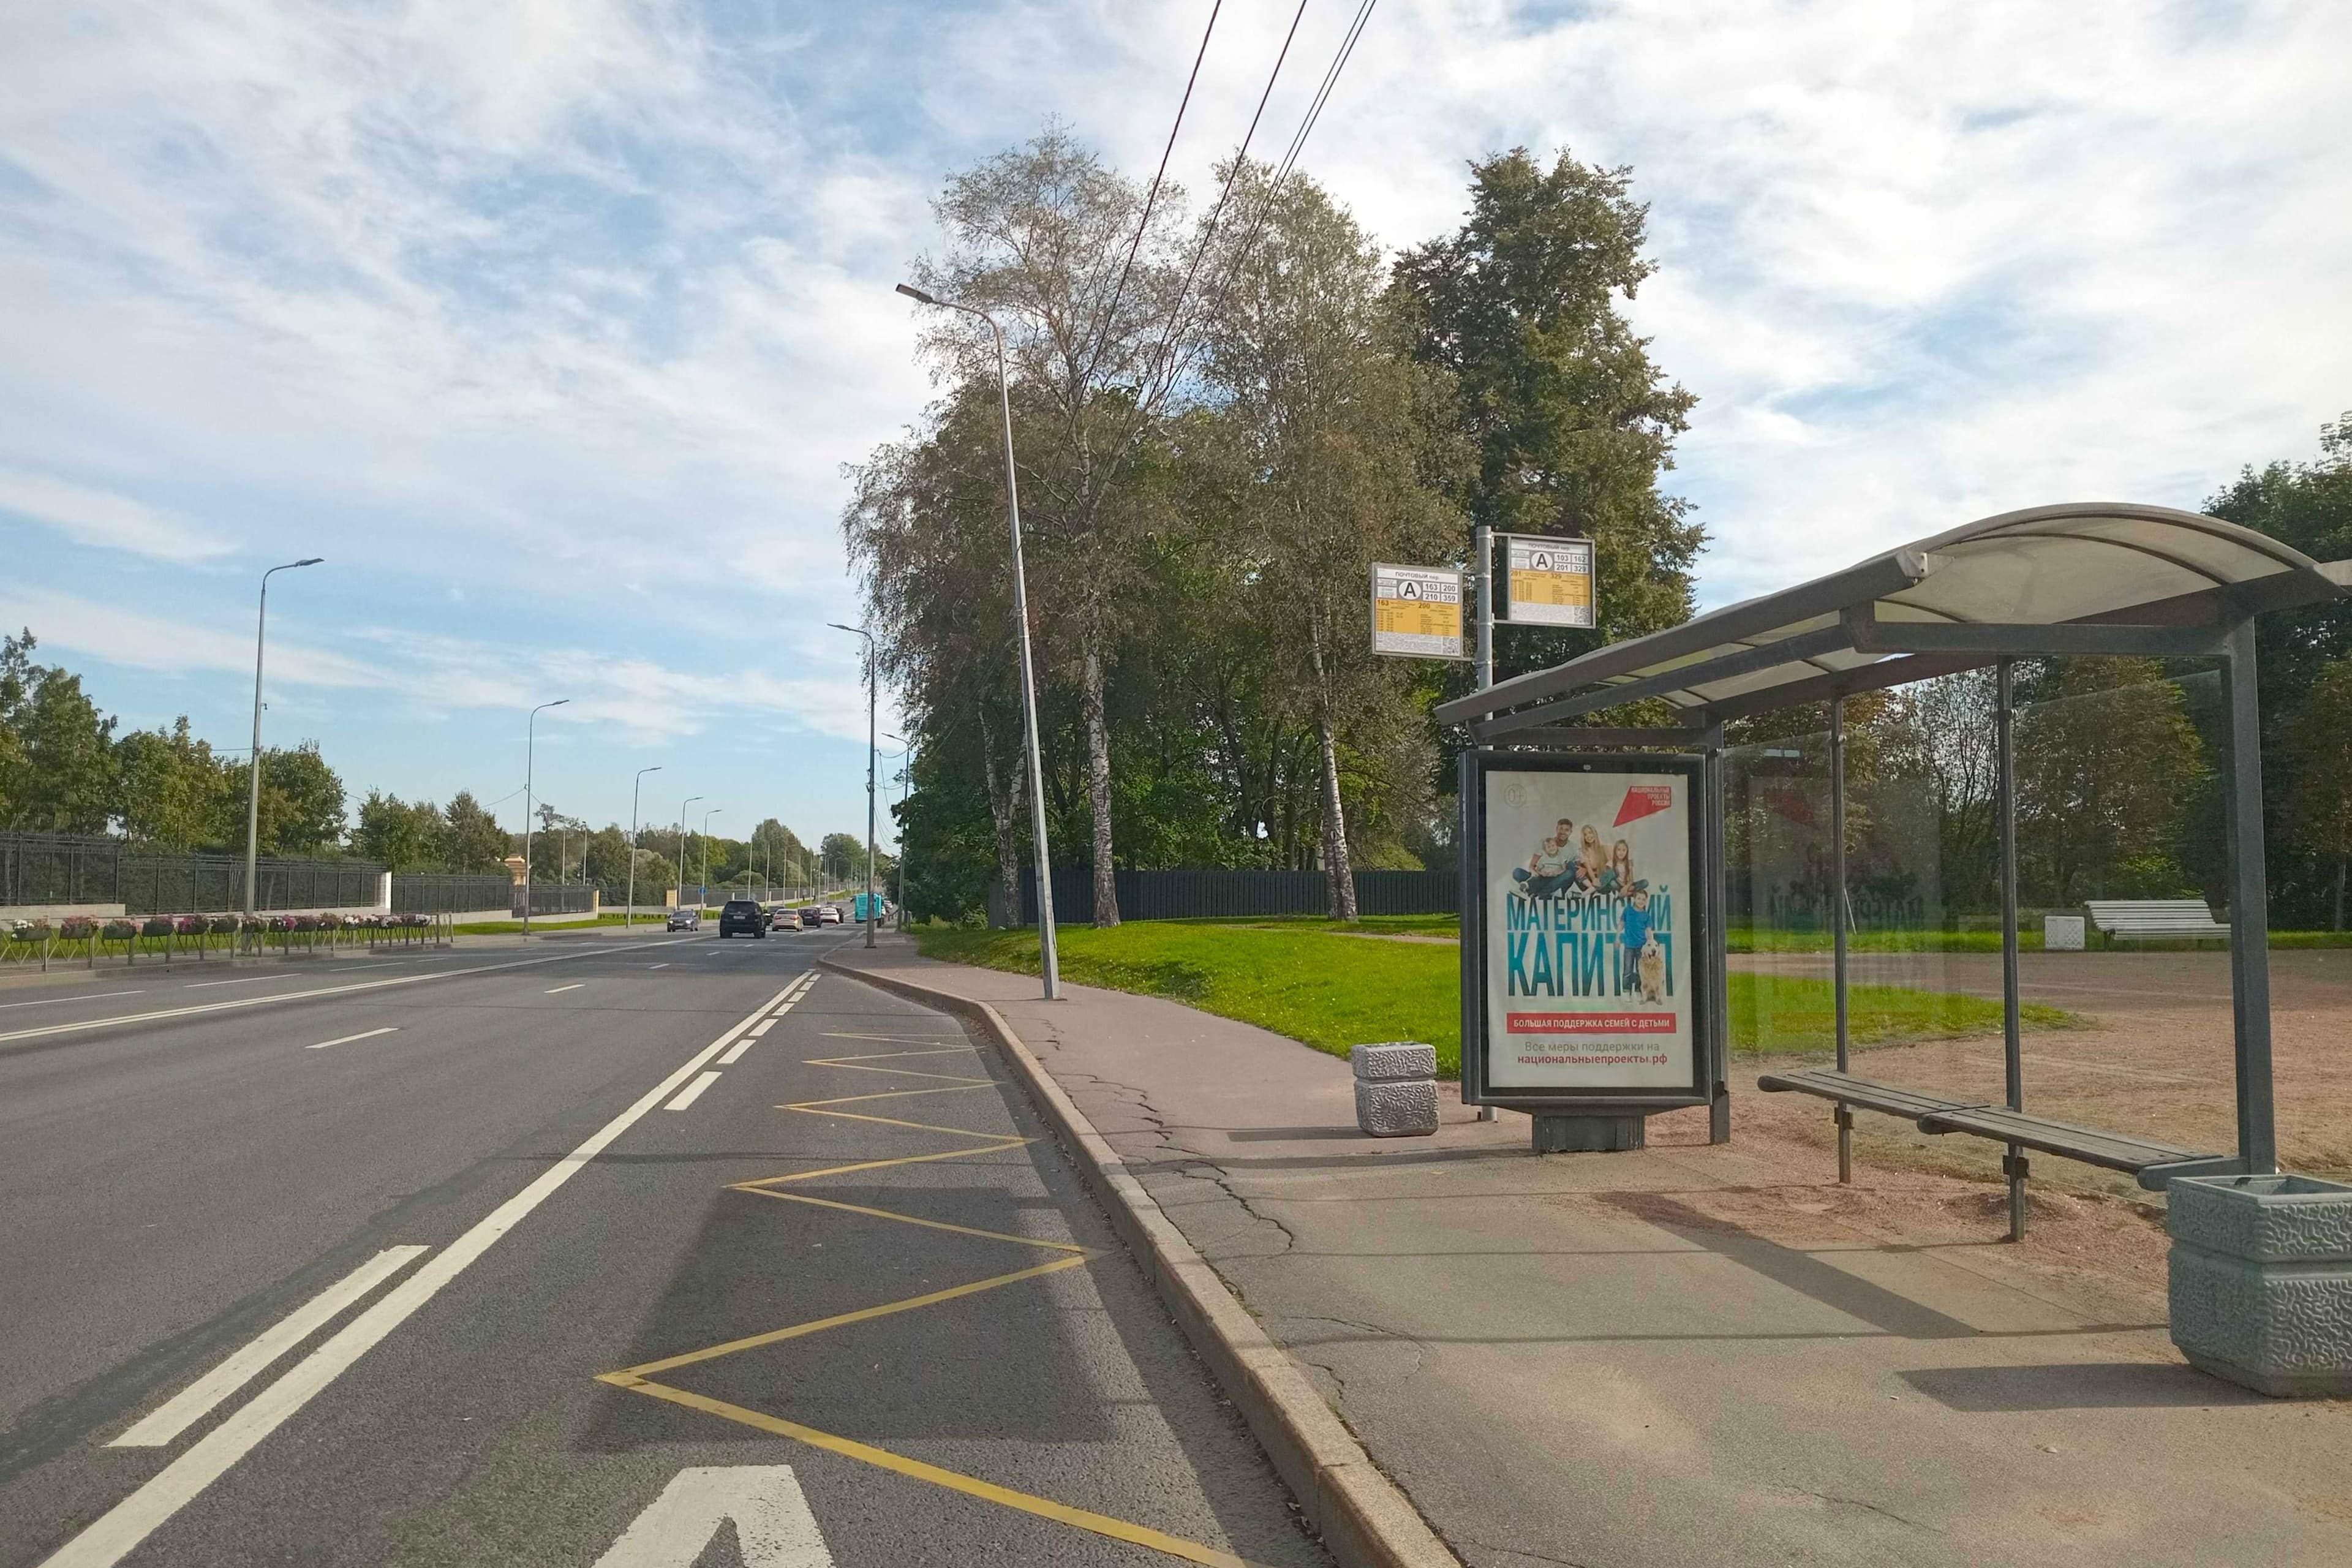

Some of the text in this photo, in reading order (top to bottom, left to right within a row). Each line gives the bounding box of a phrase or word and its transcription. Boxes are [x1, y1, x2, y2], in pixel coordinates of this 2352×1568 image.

[1506, 885, 1671, 931] МАТЕРИНСИЙ
[1507, 932, 1673, 997] КАПИТЛ
[1513, 1017, 1670, 1029] БОЛЬШАЯ ПОДДЕРЖКА СЕМЕЙ С ДЕТЬМИ
[1525, 1042, 1660, 1054] Все меры поддержки на
[1518, 1054, 1667, 1065] национальныепроекты.рф
